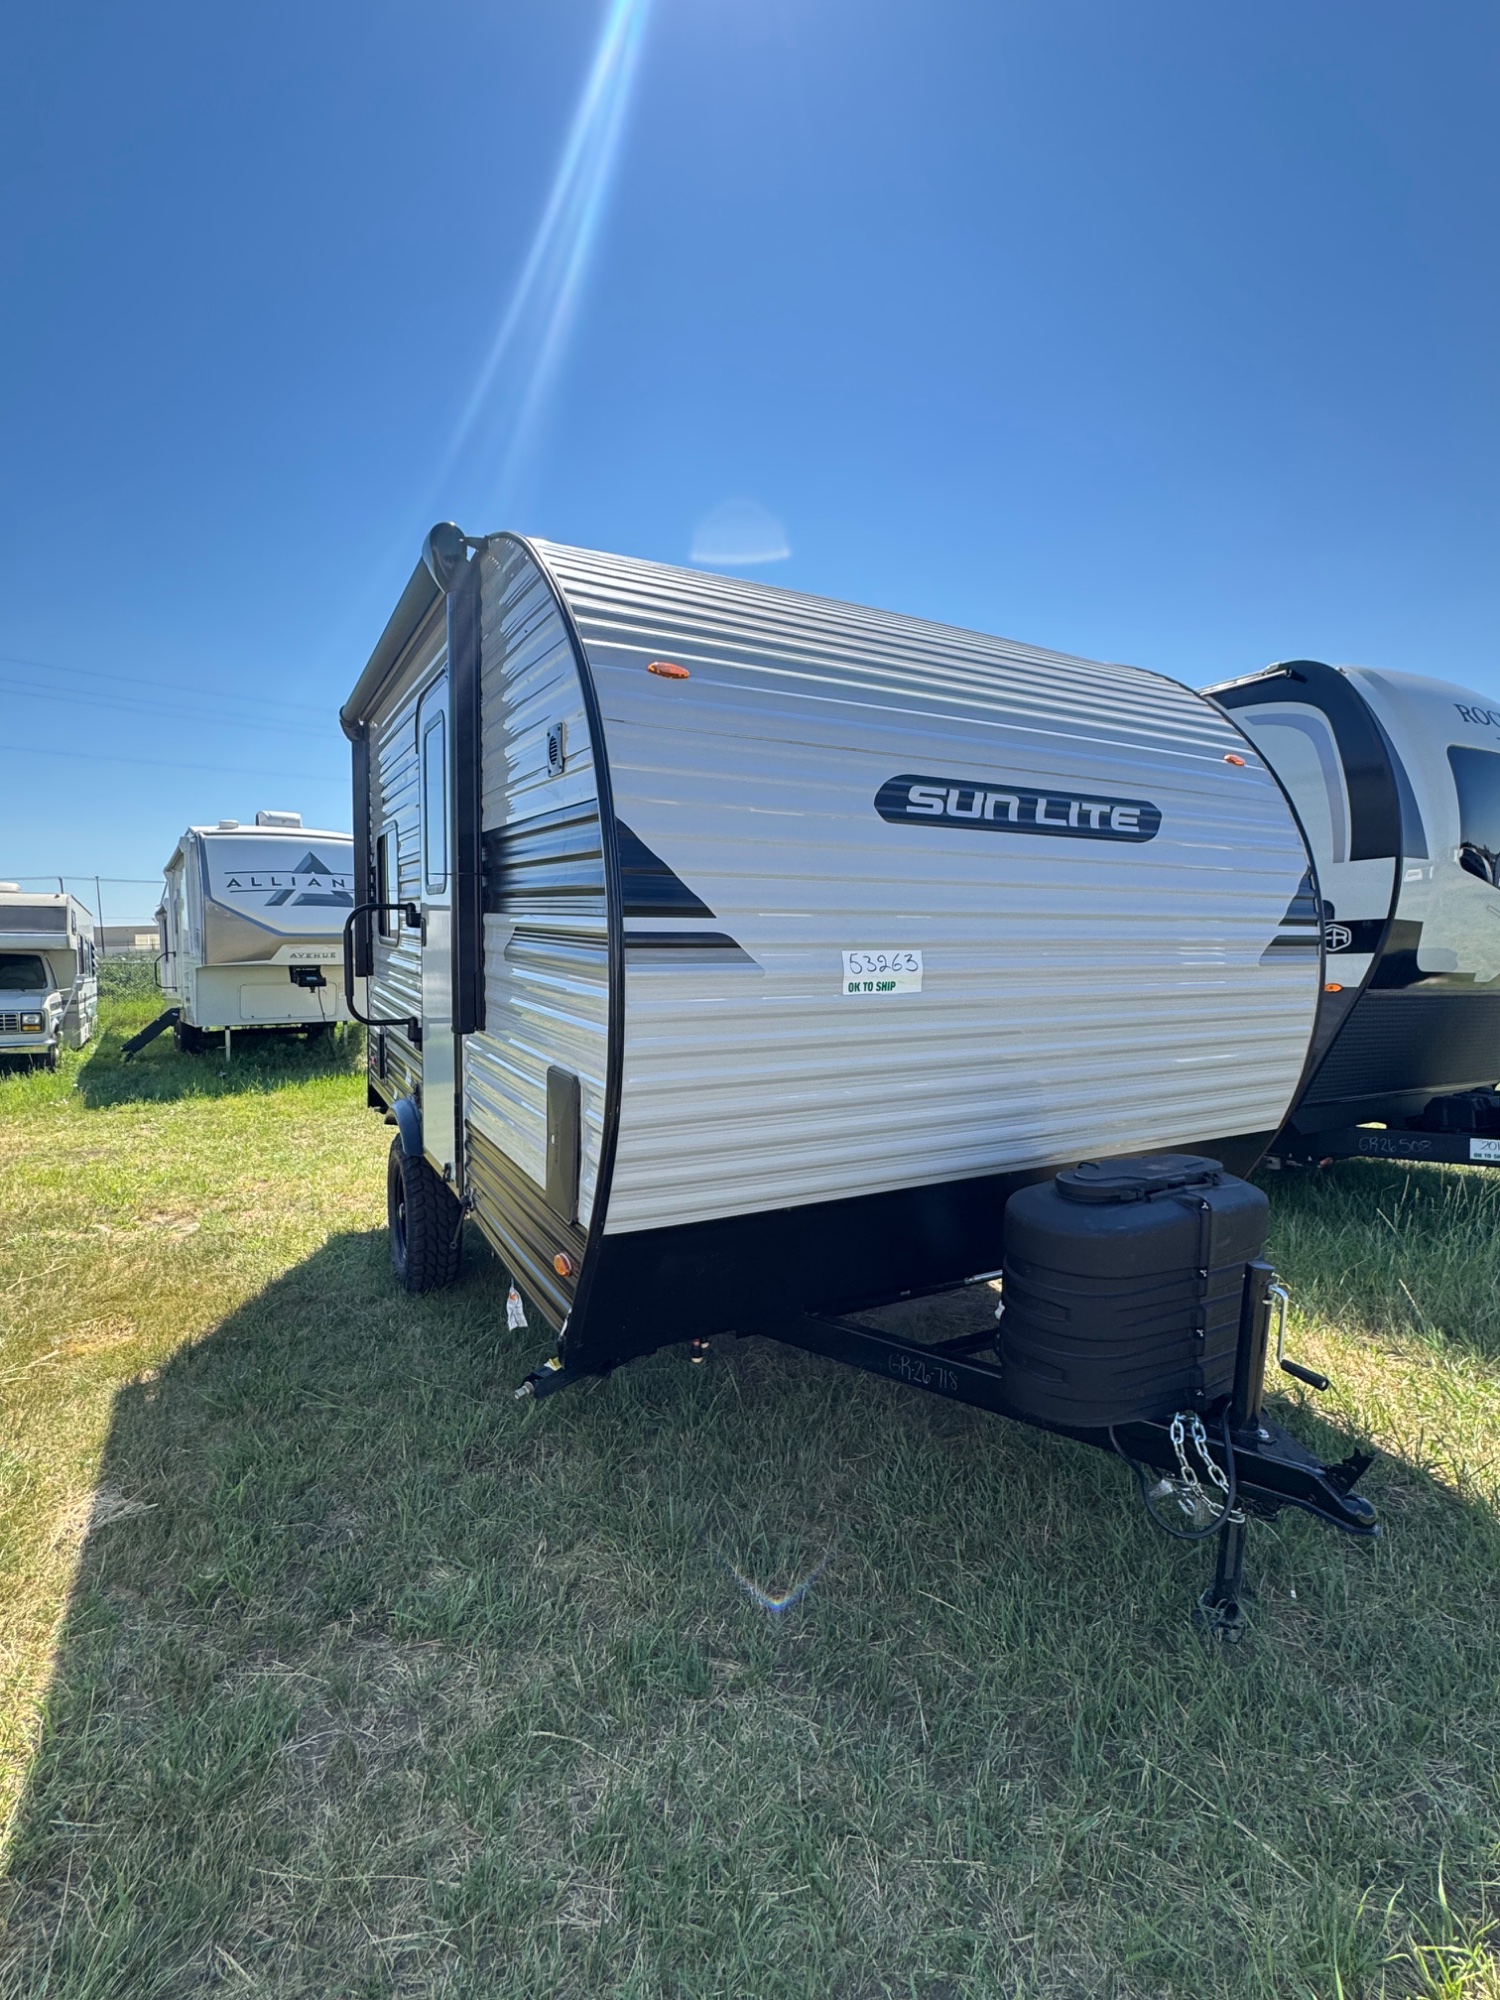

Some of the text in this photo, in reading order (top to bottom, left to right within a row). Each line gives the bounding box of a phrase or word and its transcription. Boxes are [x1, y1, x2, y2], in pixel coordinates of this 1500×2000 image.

[906, 785, 1141, 832] SUN LITE
[849, 953, 919, 975] 53263
[848, 981, 897, 993] OK TO SHIP
